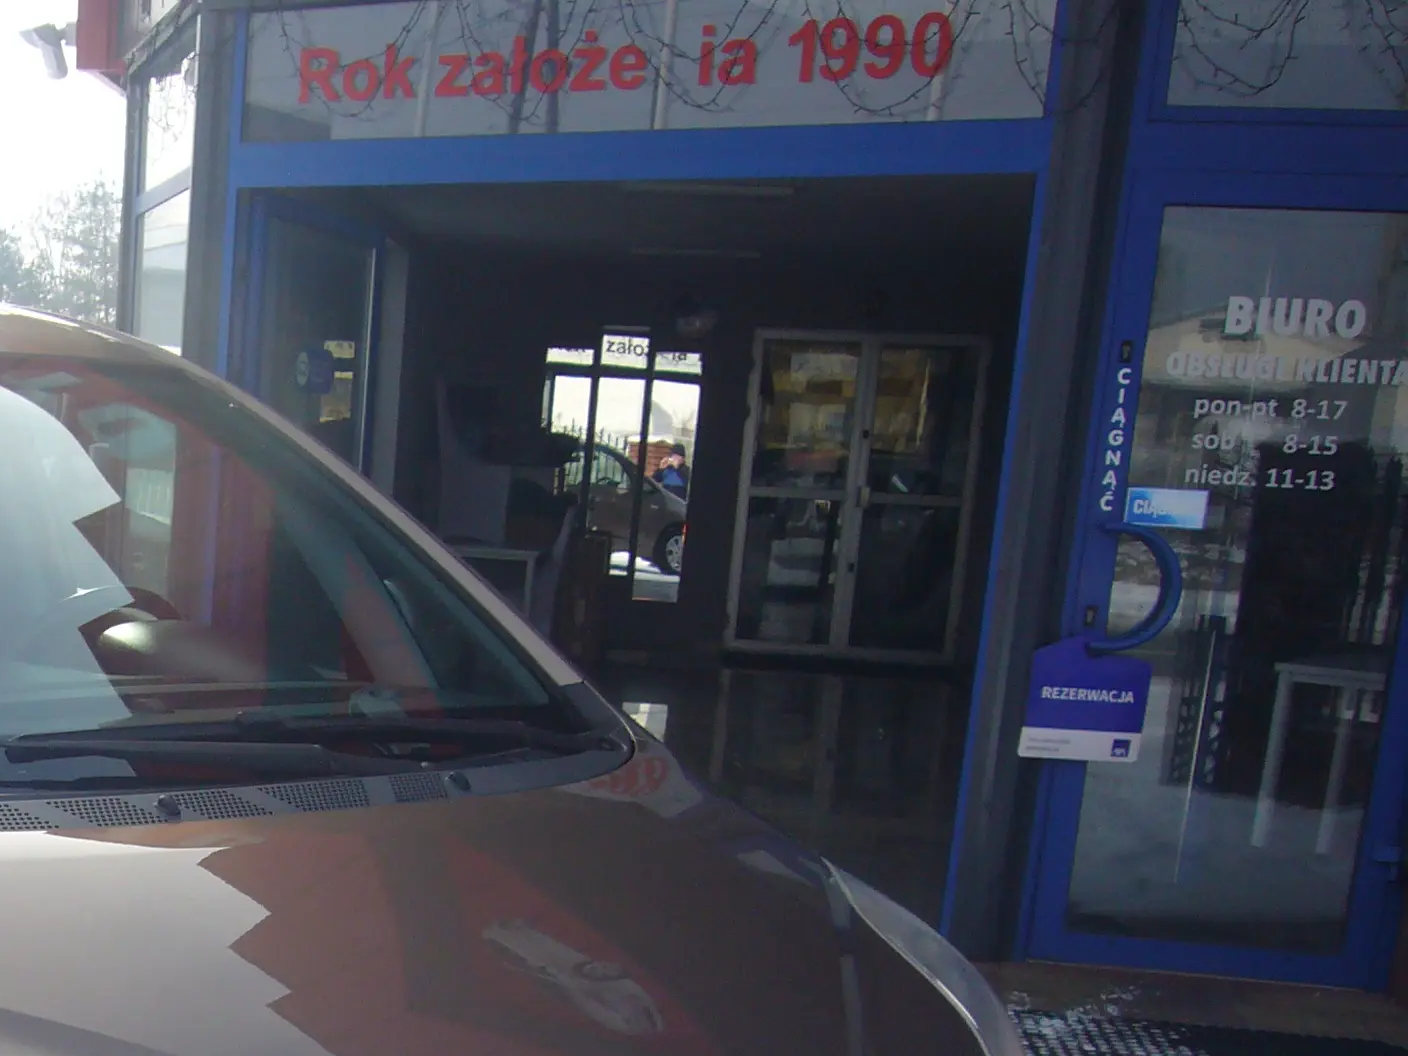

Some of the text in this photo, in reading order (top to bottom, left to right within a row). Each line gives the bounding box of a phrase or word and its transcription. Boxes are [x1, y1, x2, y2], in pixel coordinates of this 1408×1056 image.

[297, 45, 417, 105] Rok
[434, 29, 647, 98] założe
[787, 11, 955, 85] 1990
[1224, 296, 1367, 339] BIURO
[606, 337, 650, 357] zało
[1193, 397, 1348, 421] pon-pt 8-17
[1099, 367, 1133, 512] CIĄGNĄĆ
[1282, 434, 1339, 456] 8-15
[1183, 463, 1336, 491] niedz. 11-13
[1040, 685, 1135, 704] REZERWACJA
